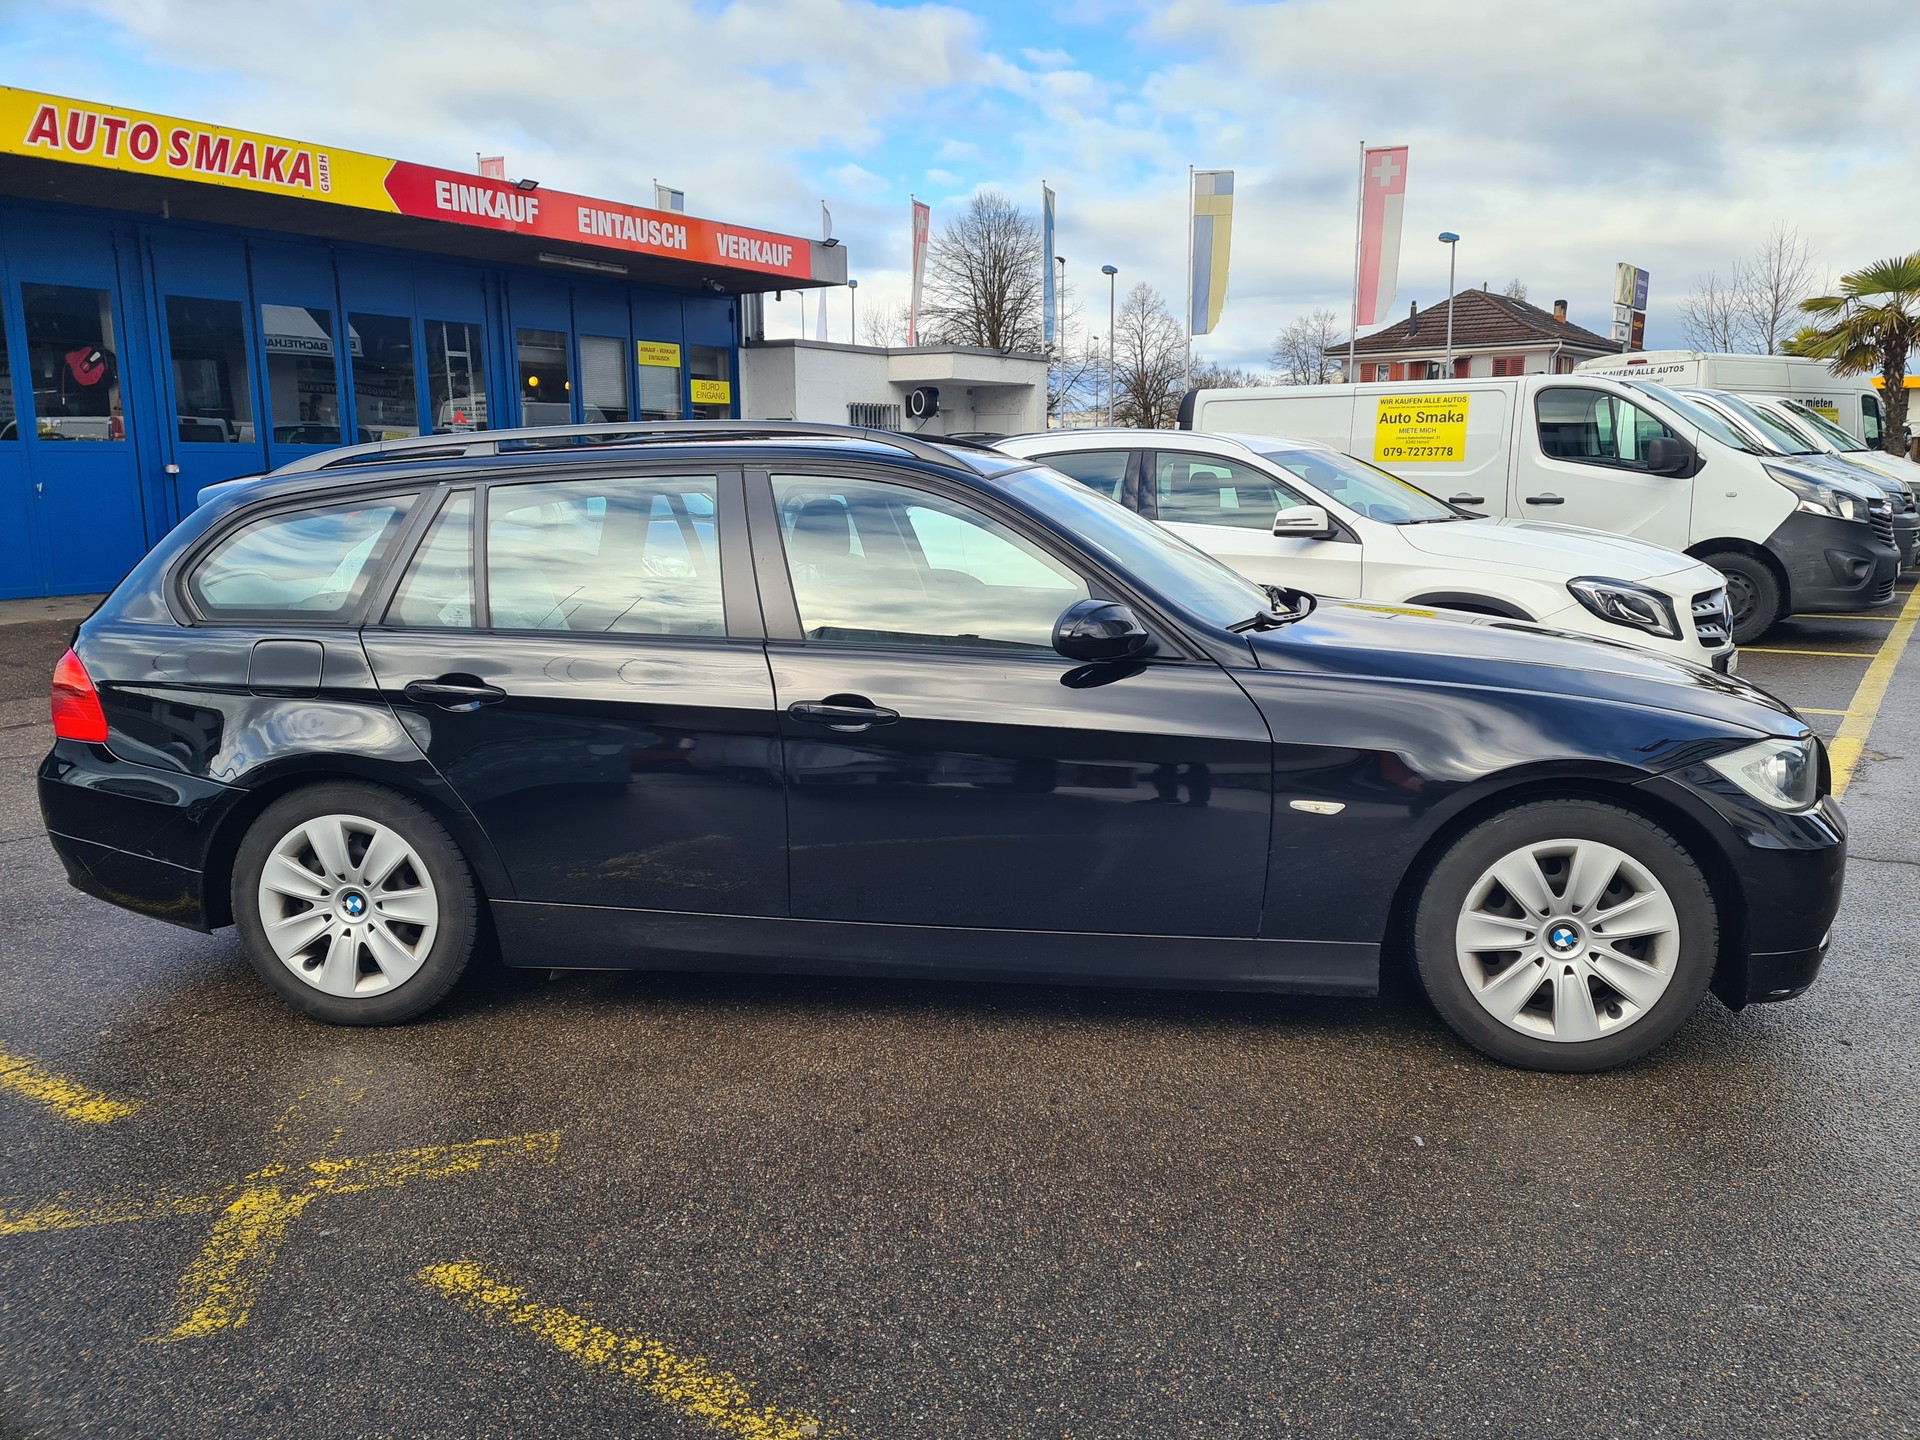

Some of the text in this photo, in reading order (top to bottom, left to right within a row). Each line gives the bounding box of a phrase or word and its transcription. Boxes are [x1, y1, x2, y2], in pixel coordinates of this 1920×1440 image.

[25, 105, 313, 189] AUTO SMAKA
[317, 153, 331, 194] GMBH
[434, 179, 792, 267] EINKAUF EINTAUSCH VERKAUF
[1635, 367, 1656, 376] ALLE
[1657, 365, 1685, 374] AUTOS
[701, 382, 720, 391] BÜRO
[696, 391, 726, 401] EINGANG
[1395, 397, 1422, 405] KAUFEN
[1424, 396, 1441, 404] ALLE
[1805, 397, 1833, 408] mieten
[1379, 410, 1464, 425] Auto Smaka
[1383, 446, 1453, 457] 079-7273778
